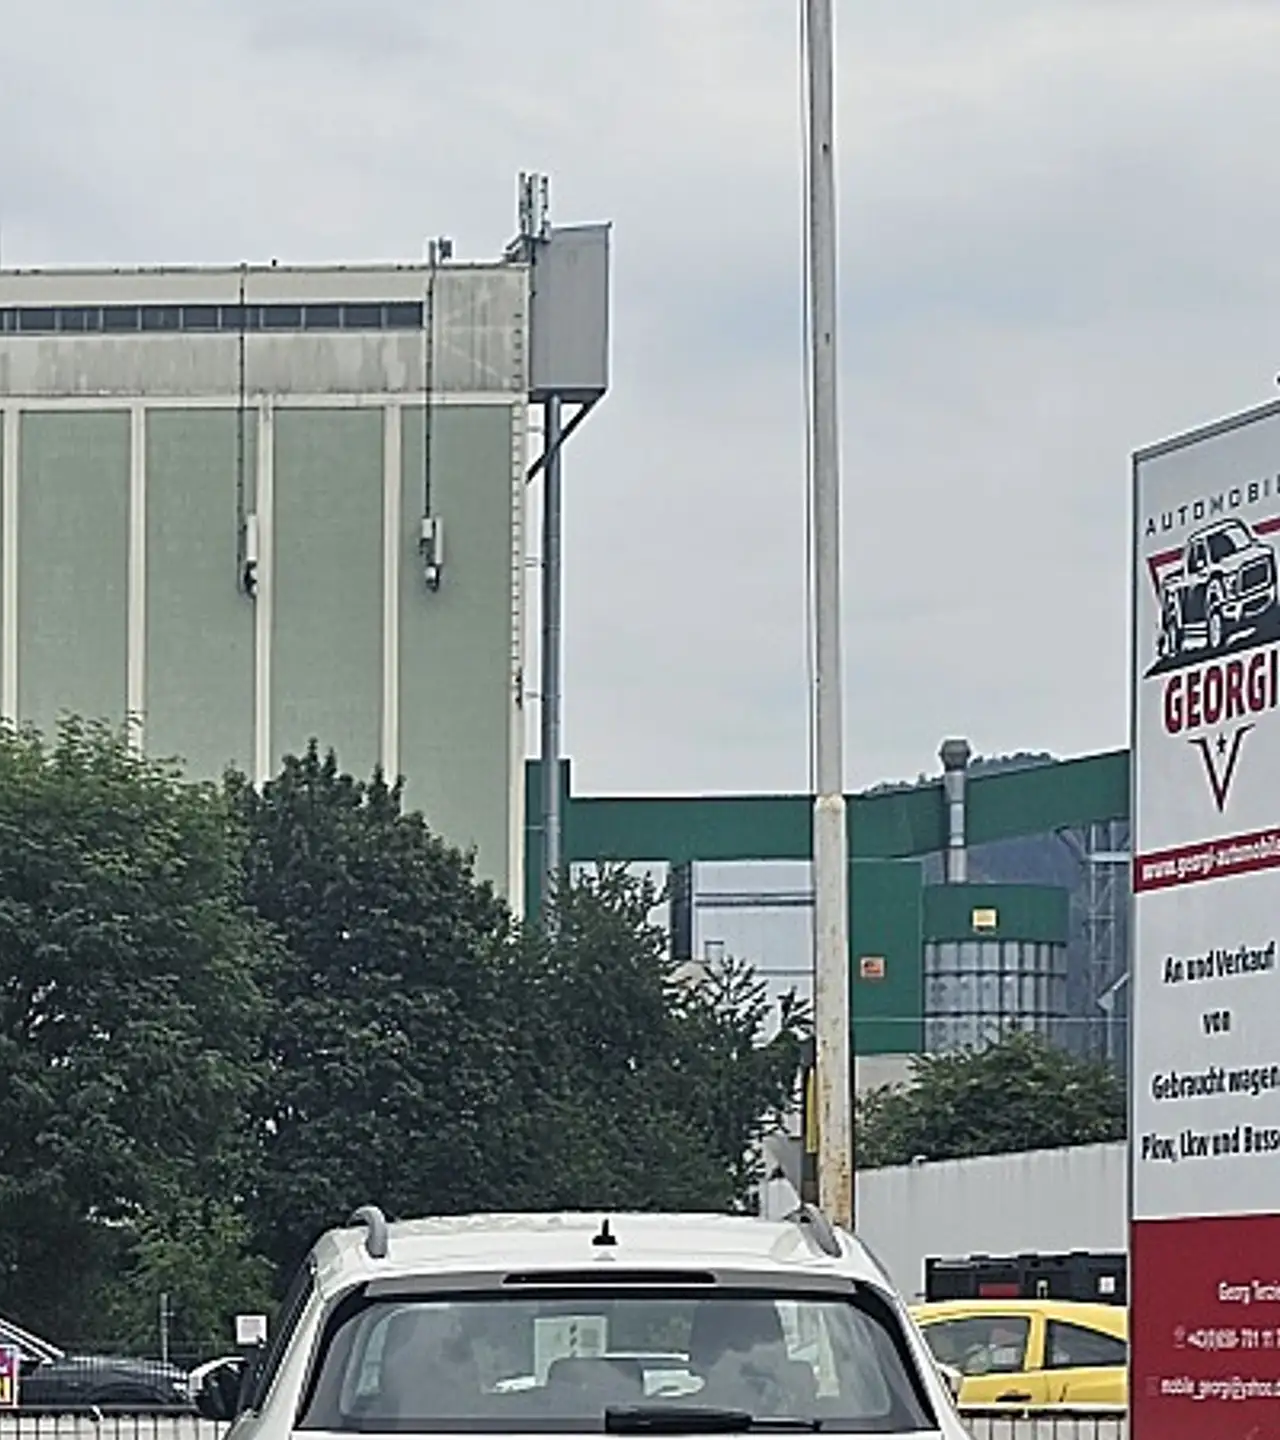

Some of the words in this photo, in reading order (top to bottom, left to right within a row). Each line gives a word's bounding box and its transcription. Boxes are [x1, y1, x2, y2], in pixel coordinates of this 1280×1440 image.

[1164, 649, 1279, 735] GEORGI
[1164, 956, 1185, 984] An
[1187, 950, 1214, 980] und
[1203, 1011, 1231, 1034] von
[1212, 1126, 1240, 1156] und
